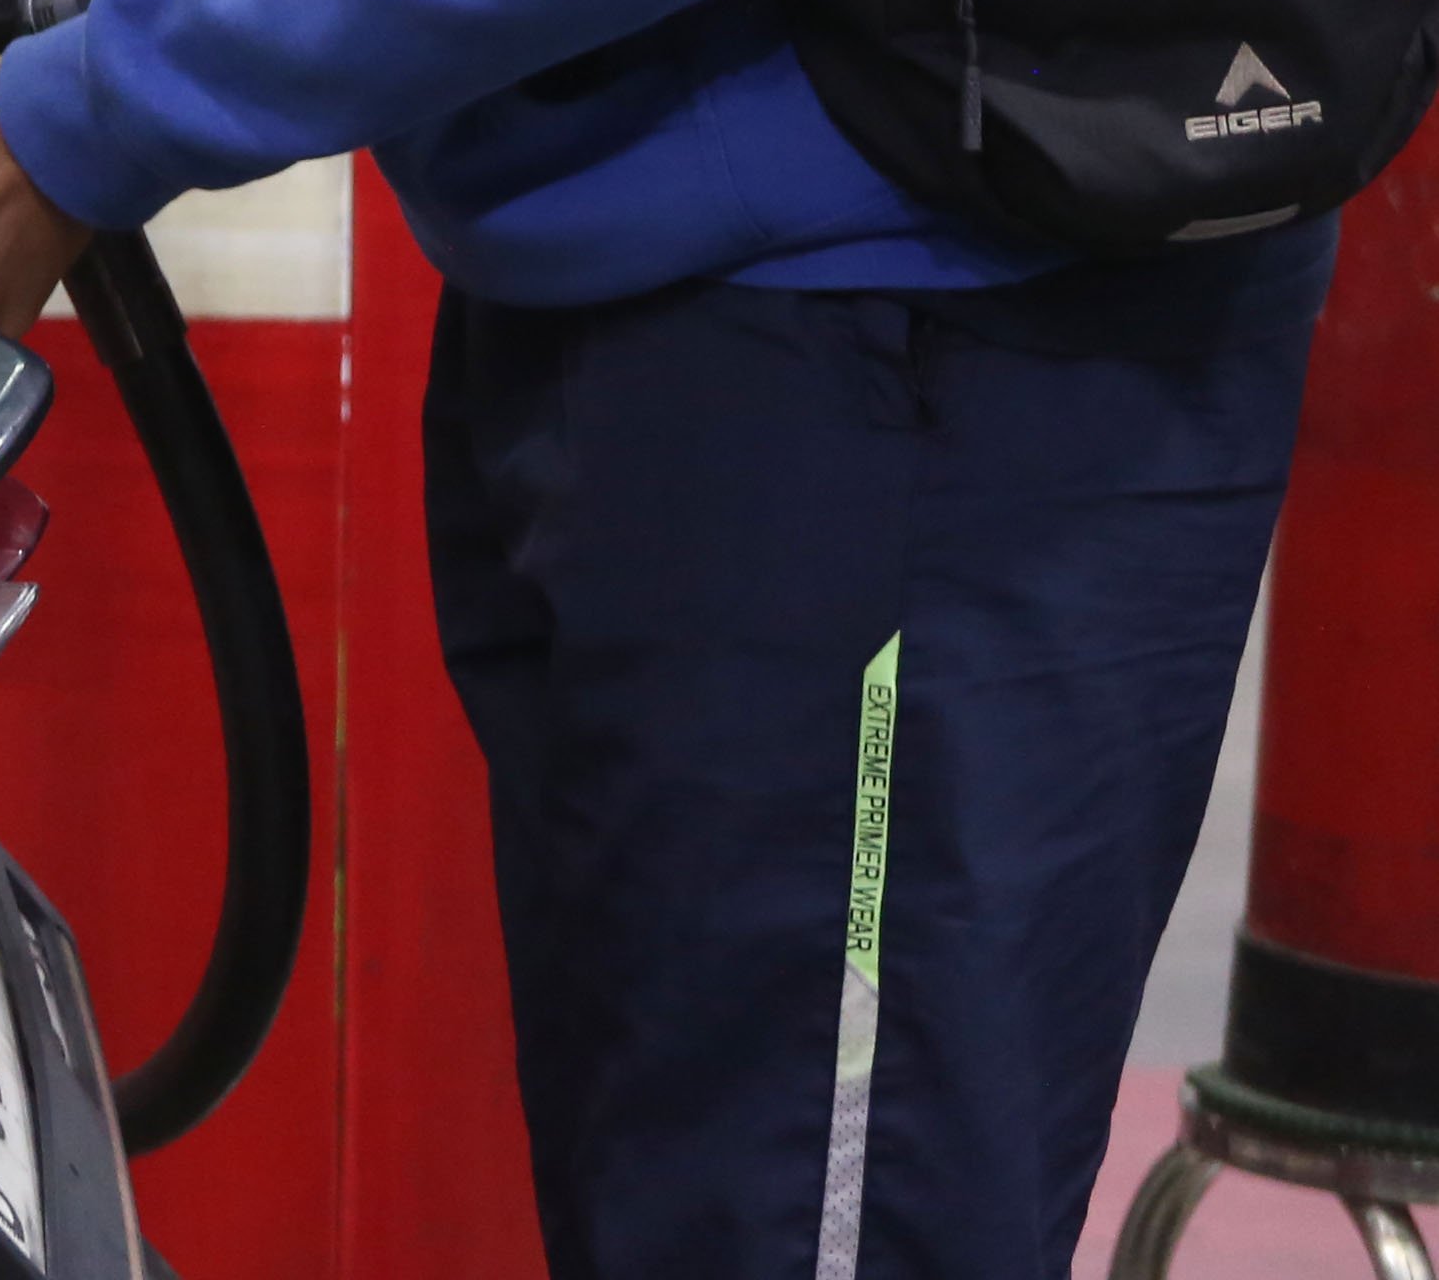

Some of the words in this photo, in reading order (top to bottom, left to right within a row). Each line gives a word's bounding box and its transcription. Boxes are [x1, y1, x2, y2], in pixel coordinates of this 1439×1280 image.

[1185, 100, 1323, 140] EIGER
[862, 684, 891, 789] EXTREME
[855, 794, 886, 881] PRIMER
[846, 887, 878, 952] WEAR
